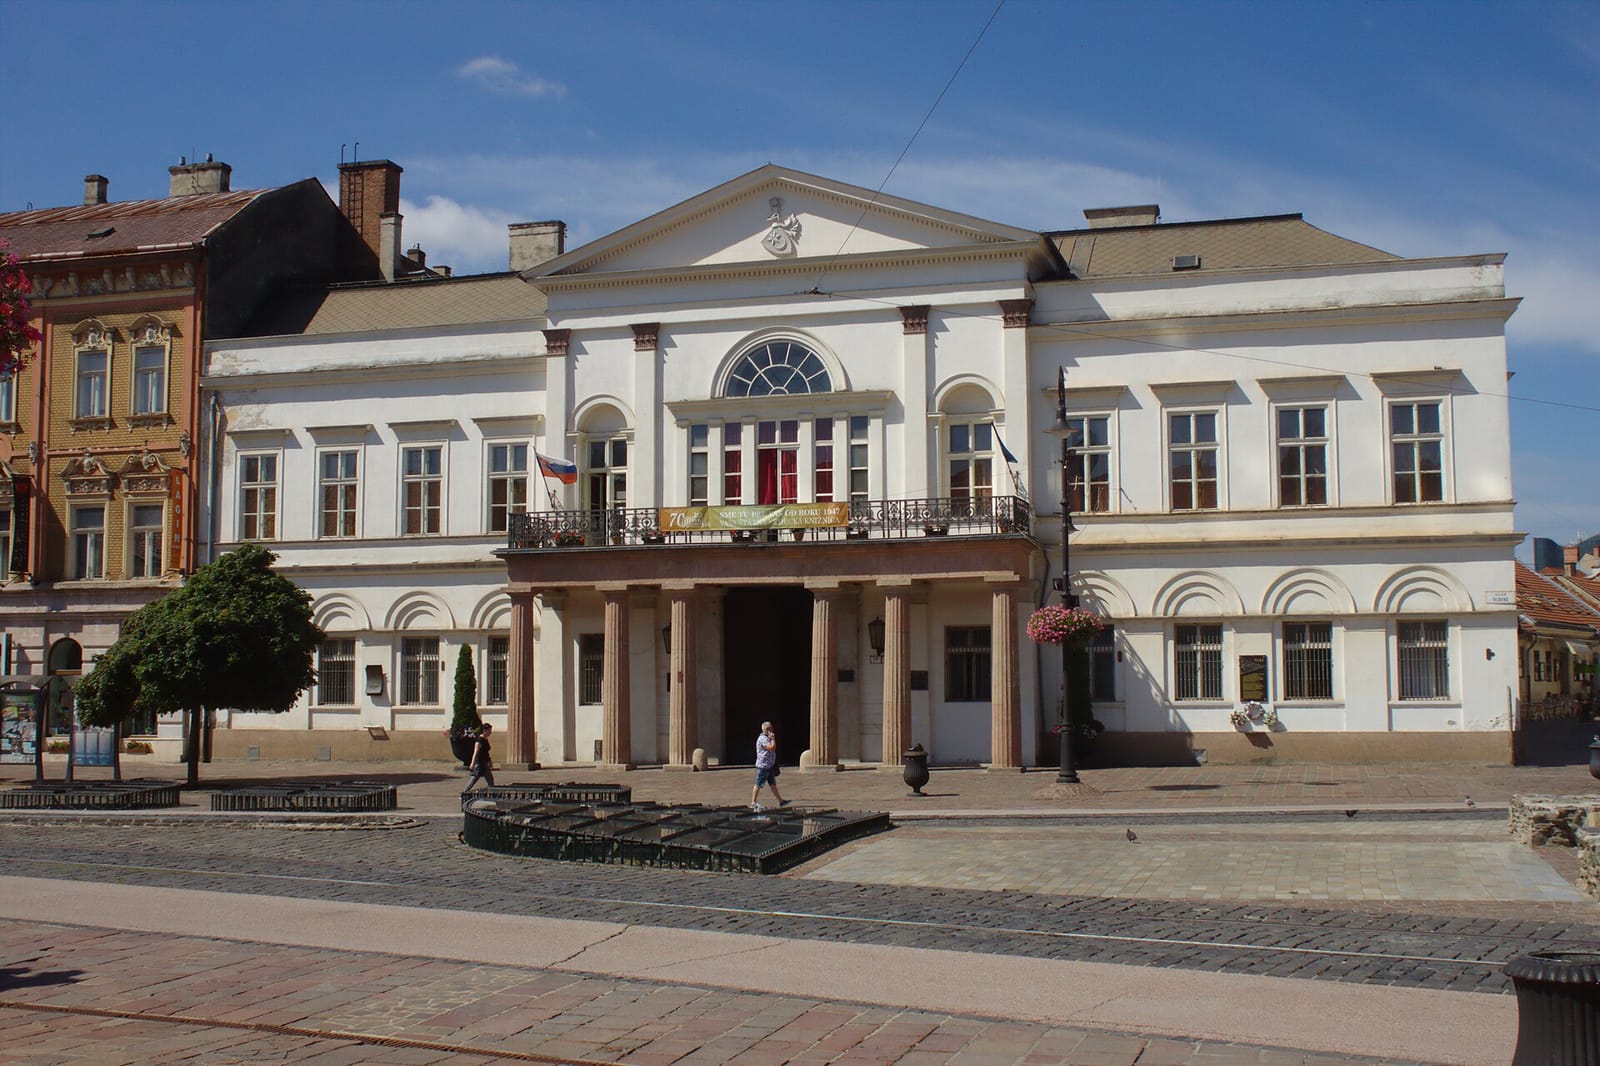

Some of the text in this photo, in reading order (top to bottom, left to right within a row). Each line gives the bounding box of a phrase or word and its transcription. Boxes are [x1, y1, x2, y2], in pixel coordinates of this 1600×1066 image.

[720, 511, 737, 519] SME
[784, 509, 797, 517] OD
[798, 508, 821, 516] ROKU
[823, 507, 841, 516] 1947
